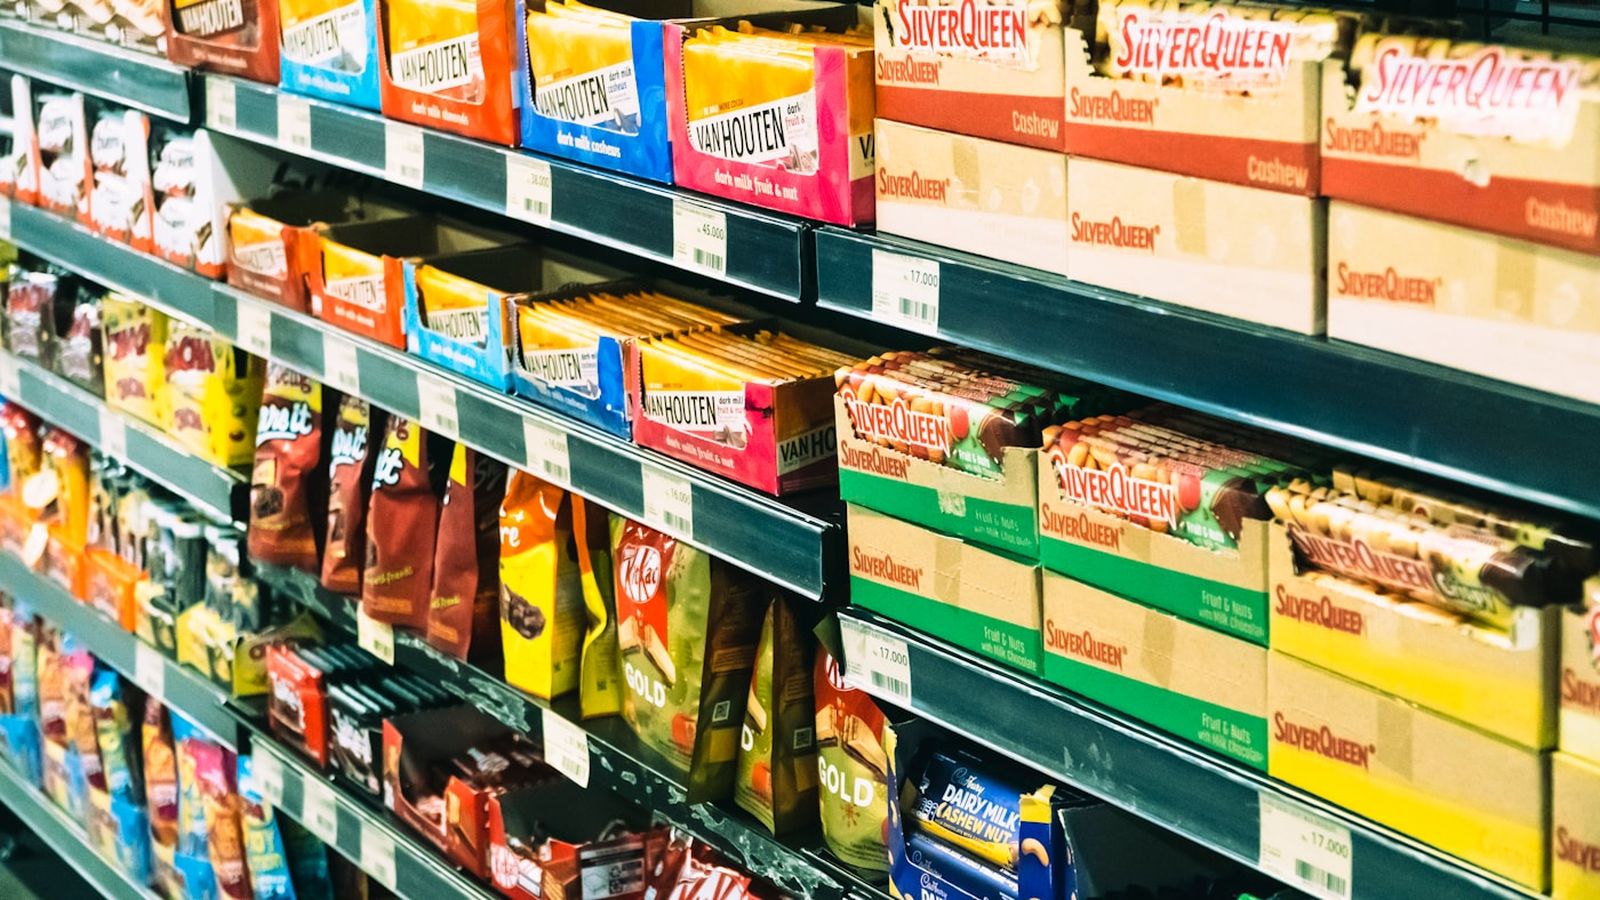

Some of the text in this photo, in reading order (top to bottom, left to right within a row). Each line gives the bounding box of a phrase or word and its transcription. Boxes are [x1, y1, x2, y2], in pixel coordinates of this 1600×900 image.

[1012, 110, 1060, 140] Cashew
[714, 167, 734, 187] dark
[733, 172, 754, 192] milk
[754, 176, 775, 197] fruit
[782, 185, 799, 201] nut
[1247, 155, 1310, 190] Cashew
[702, 222, 725, 241] 45.000
[1524, 196, 1599, 238] Cashew
[910, 269, 938, 288] 17.000
[879, 645, 908, 667] 17.000
[624, 660, 667, 709] GOLD
[818, 754, 874, 808] GOLD
[935, 801, 1013, 846] CASHEW NUT
[941, 783, 1020, 832] DAIRY MILK
[1311, 831, 1349, 859] 17.000
